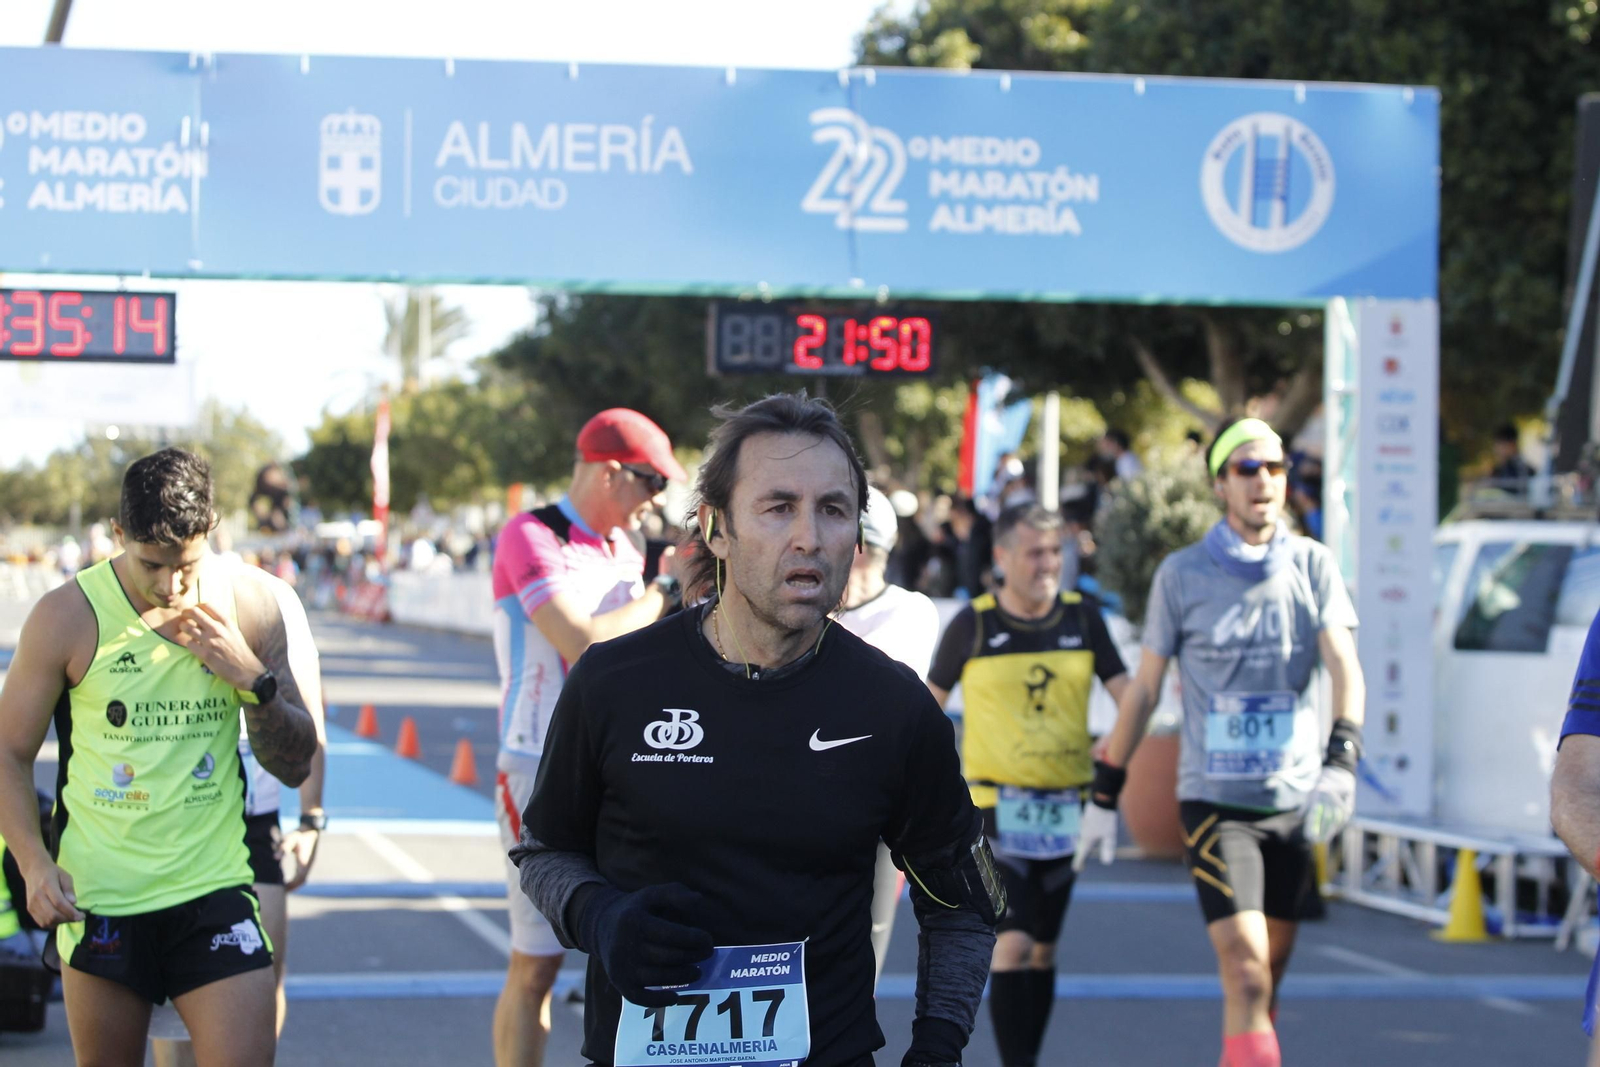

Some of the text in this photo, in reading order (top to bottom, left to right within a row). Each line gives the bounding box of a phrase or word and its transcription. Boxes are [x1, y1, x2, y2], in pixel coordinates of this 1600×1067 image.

[29, 111, 146, 142] MEDIO
[436, 116, 693, 174] ALMERÍA
[930, 136, 1041, 168] MEDIO
[28, 141, 207, 178] MARATÓN
[28, 177, 188, 213] ALMERÍA
[434, 176, 568, 210] CIUDAD
[929, 165, 1098, 202] MARATÓN
[929, 202, 1082, 236] ALMERÍA
[135, 697, 228, 713] FUNERARIA
[103, 732, 154, 743] TANATORIO
[1228, 716, 1275, 739] 801
[631, 753, 714, 763] Escuela de Porteros
[94, 787, 150, 802] segurelite
[1015, 803, 1063, 824] 475
[730, 963, 790, 978] MARATÓN
[750, 952, 790, 964] MEDIO
[643, 988, 786, 1042] 1717
[646, 1039, 778, 1056] CASAENALMERIA
